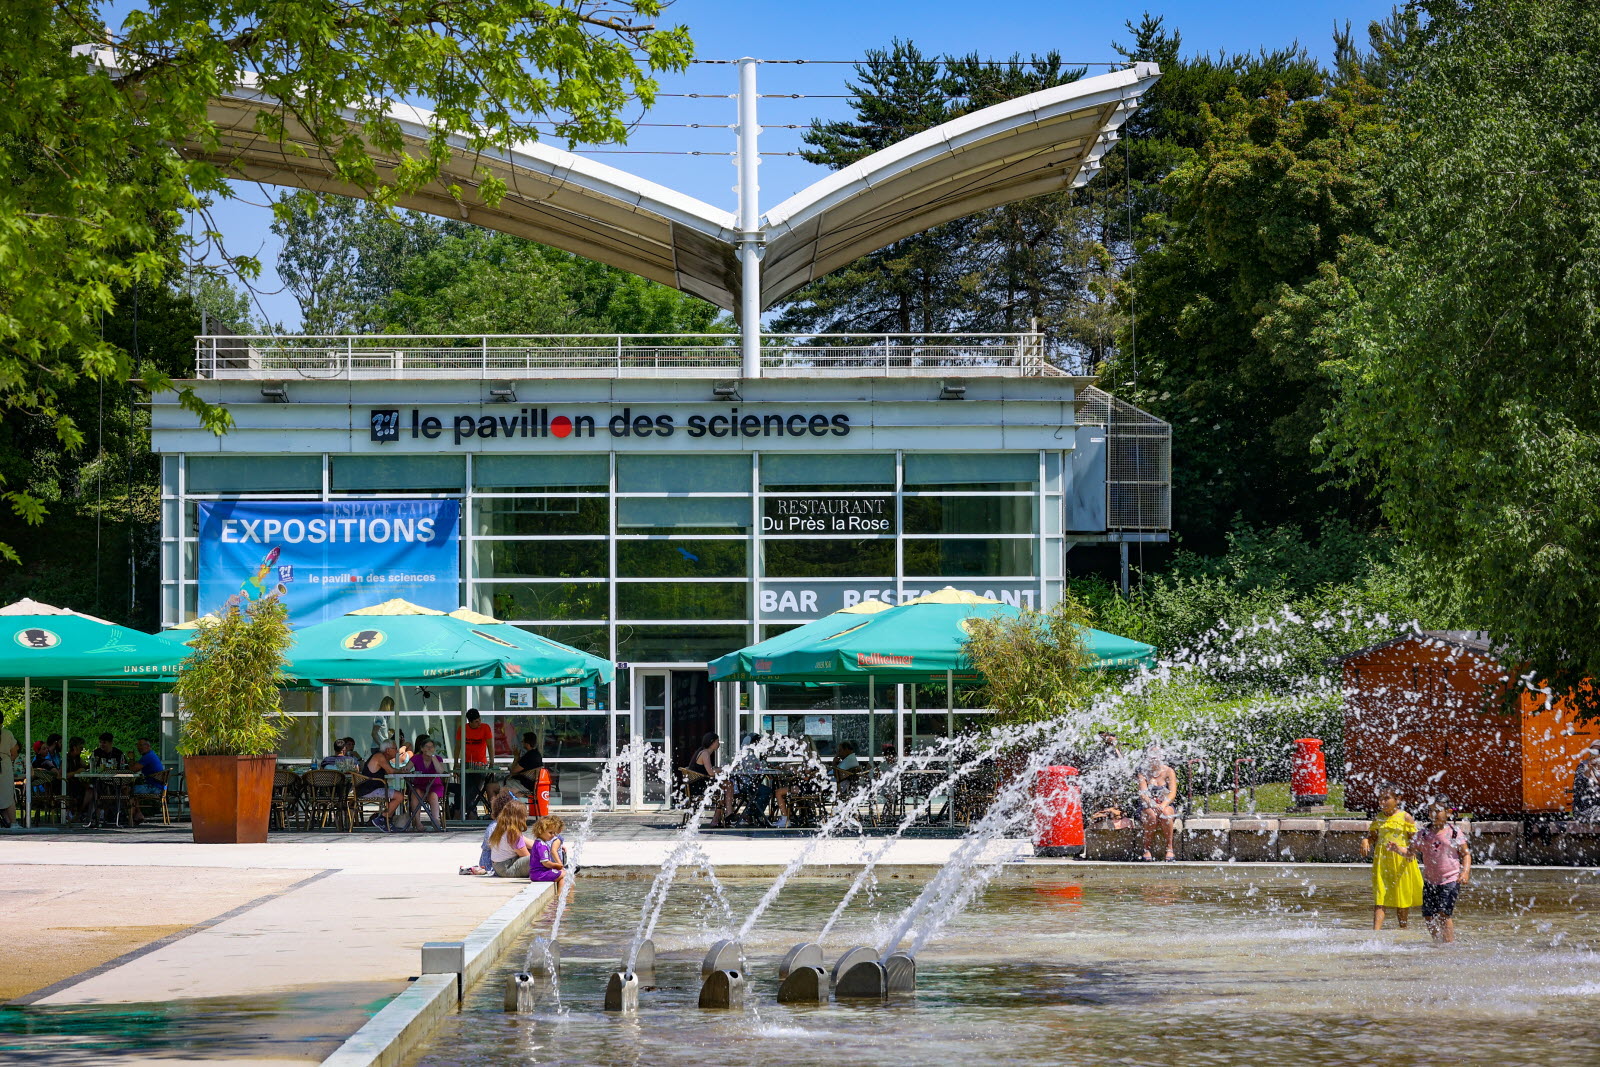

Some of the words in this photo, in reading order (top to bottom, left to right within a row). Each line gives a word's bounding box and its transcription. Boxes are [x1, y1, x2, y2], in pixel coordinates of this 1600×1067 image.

[412, 409, 442, 439] le
[608, 408, 675, 438] des
[687, 408, 851, 438] sciences
[777, 499, 886, 515] RESTAURANT
[221, 518, 436, 544] EXPOSITIONS
[761, 516, 784, 531] Du
[789, 516, 826, 531] Près
[831, 516, 846, 530] la
[848, 516, 890, 531] Rose
[309, 573, 319, 583] le
[366, 573, 386, 583] des
[388, 573, 436, 583] sciences
[760, 590, 819, 613] BAR
[856, 652, 915, 665] Bellheimer
[124, 665, 158, 673] UNSER
[423, 669, 456, 677] UNSER
[459, 669, 481, 677] BIER
